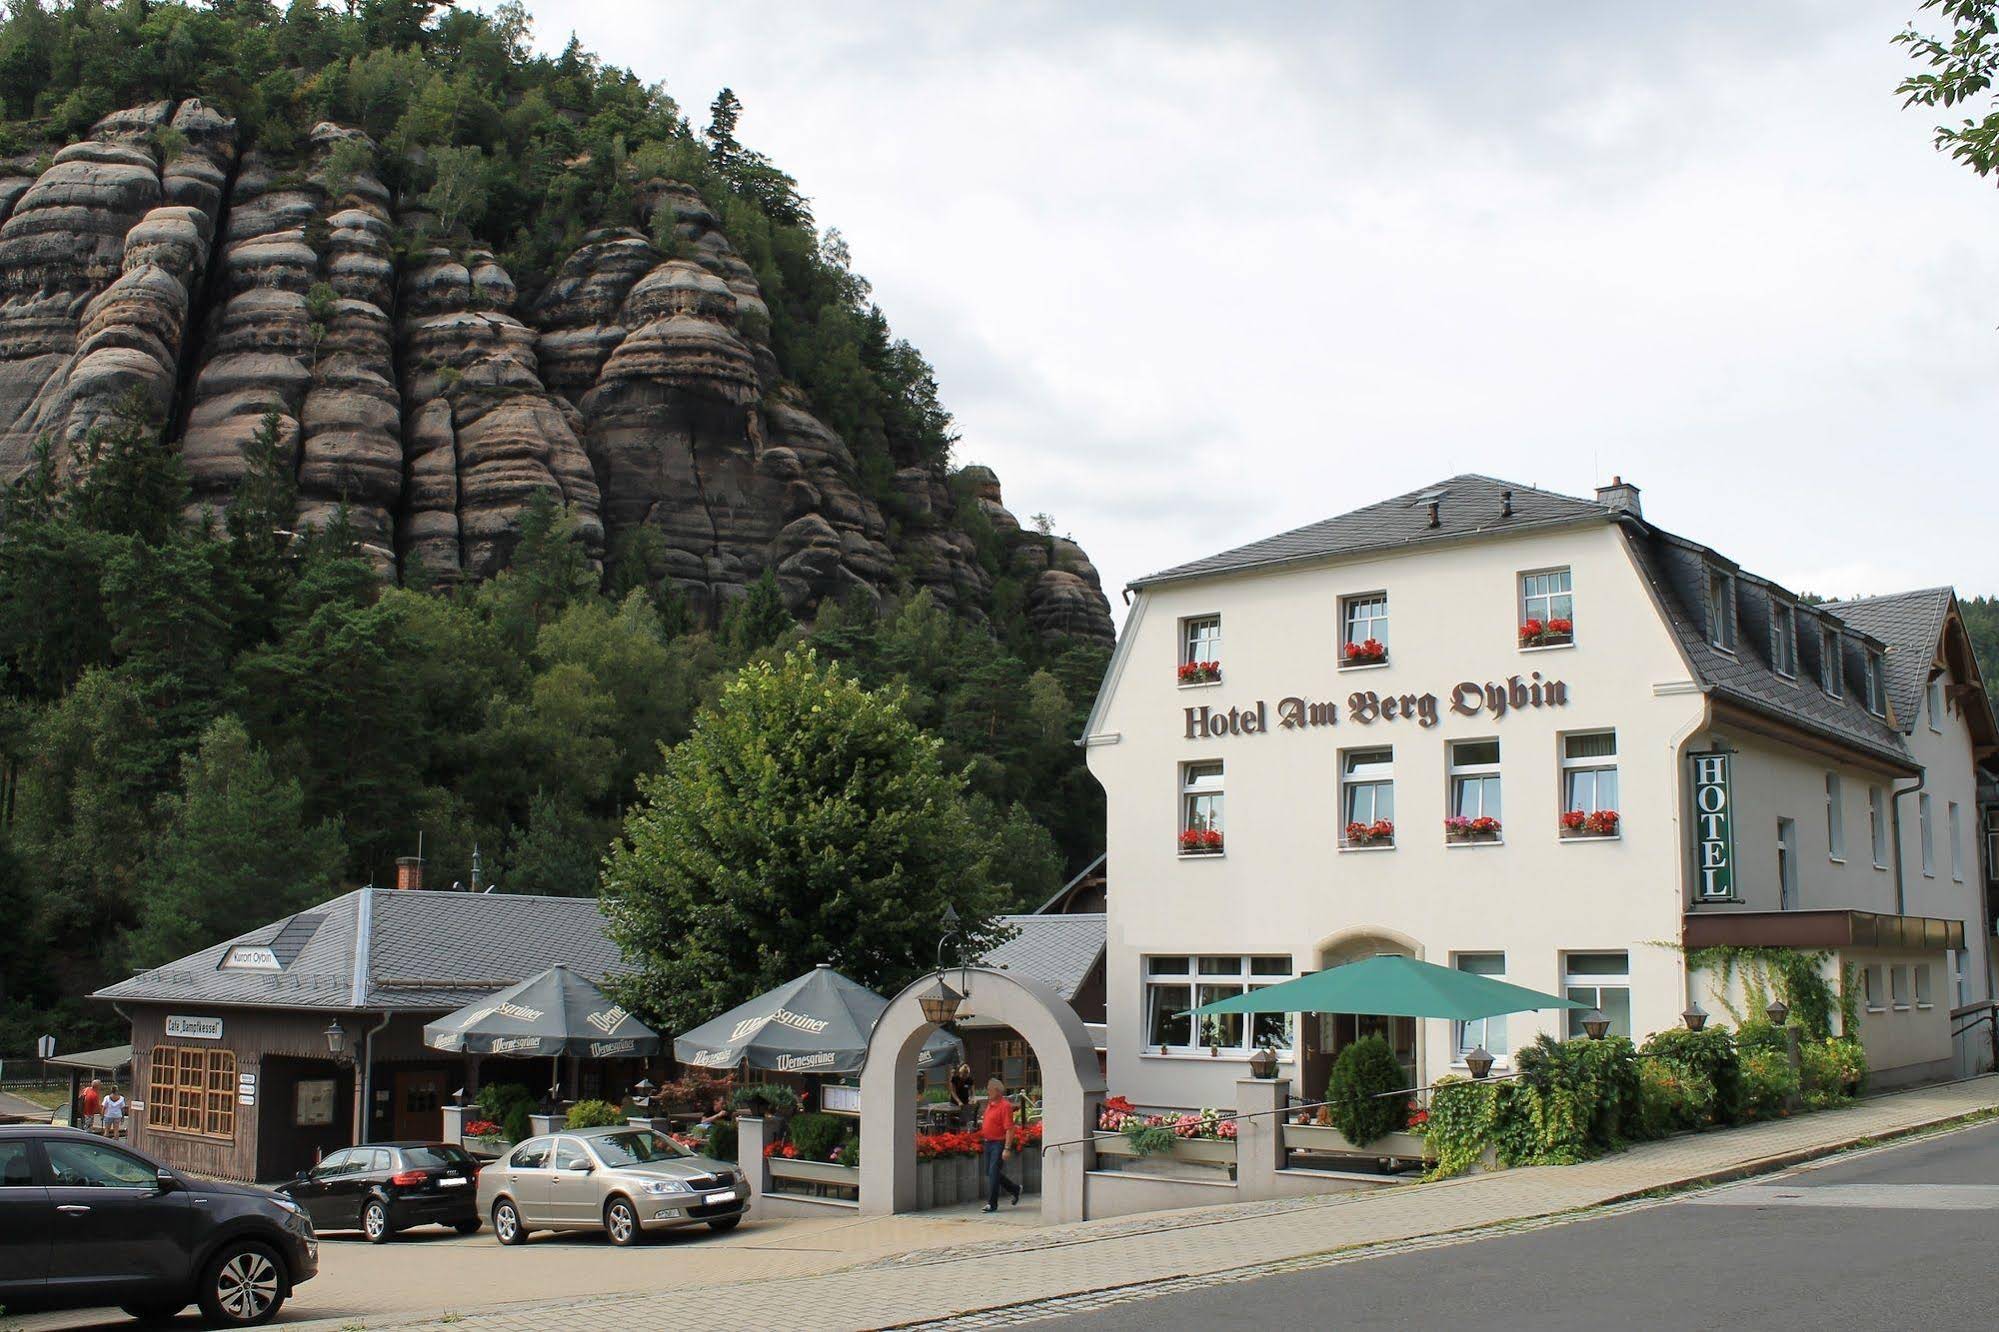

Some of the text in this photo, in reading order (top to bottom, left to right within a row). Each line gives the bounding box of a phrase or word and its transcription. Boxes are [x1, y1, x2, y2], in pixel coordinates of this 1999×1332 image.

[1184, 671, 1568, 739] Hotel Am Berg Oybin
[1696, 757, 1727, 895] HOTEL
[233, 952, 271, 964] Kurort Oybin
[491, 1036, 541, 1053] Wernesgrüner
[591, 1040, 635, 1057] Wernesgrüner
[776, 1051, 836, 1071] Wernesgrüner
